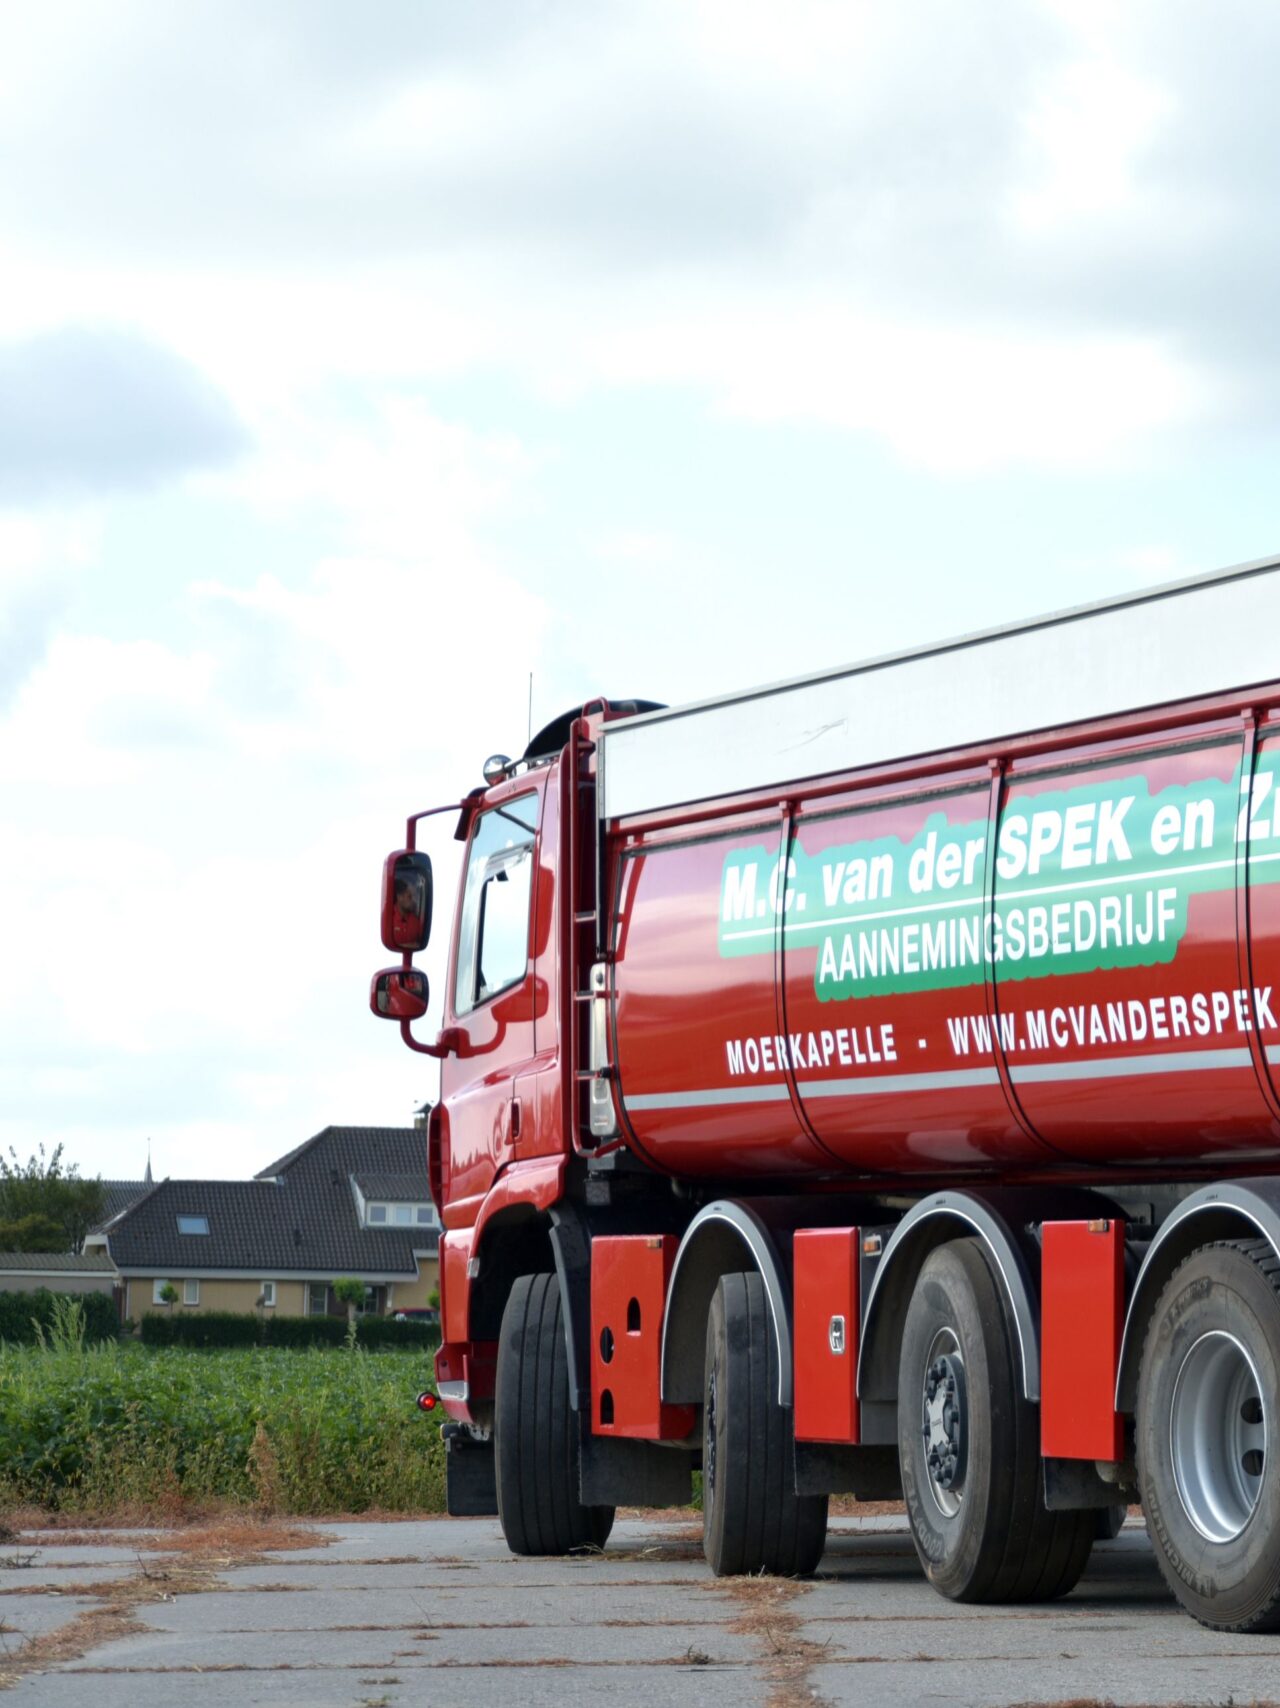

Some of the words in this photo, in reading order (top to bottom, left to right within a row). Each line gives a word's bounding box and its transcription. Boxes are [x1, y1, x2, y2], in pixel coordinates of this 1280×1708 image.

[722, 856, 807, 922] M.C.
[822, 853, 894, 908] van
[908, 831, 985, 894] der
[996, 796, 1136, 880] SPEK
[1151, 798, 1215, 855] en
[819, 887, 1177, 984] AANNEMINGSBEDRIJF
[726, 1024, 898, 1076] MOERKAPELLE
